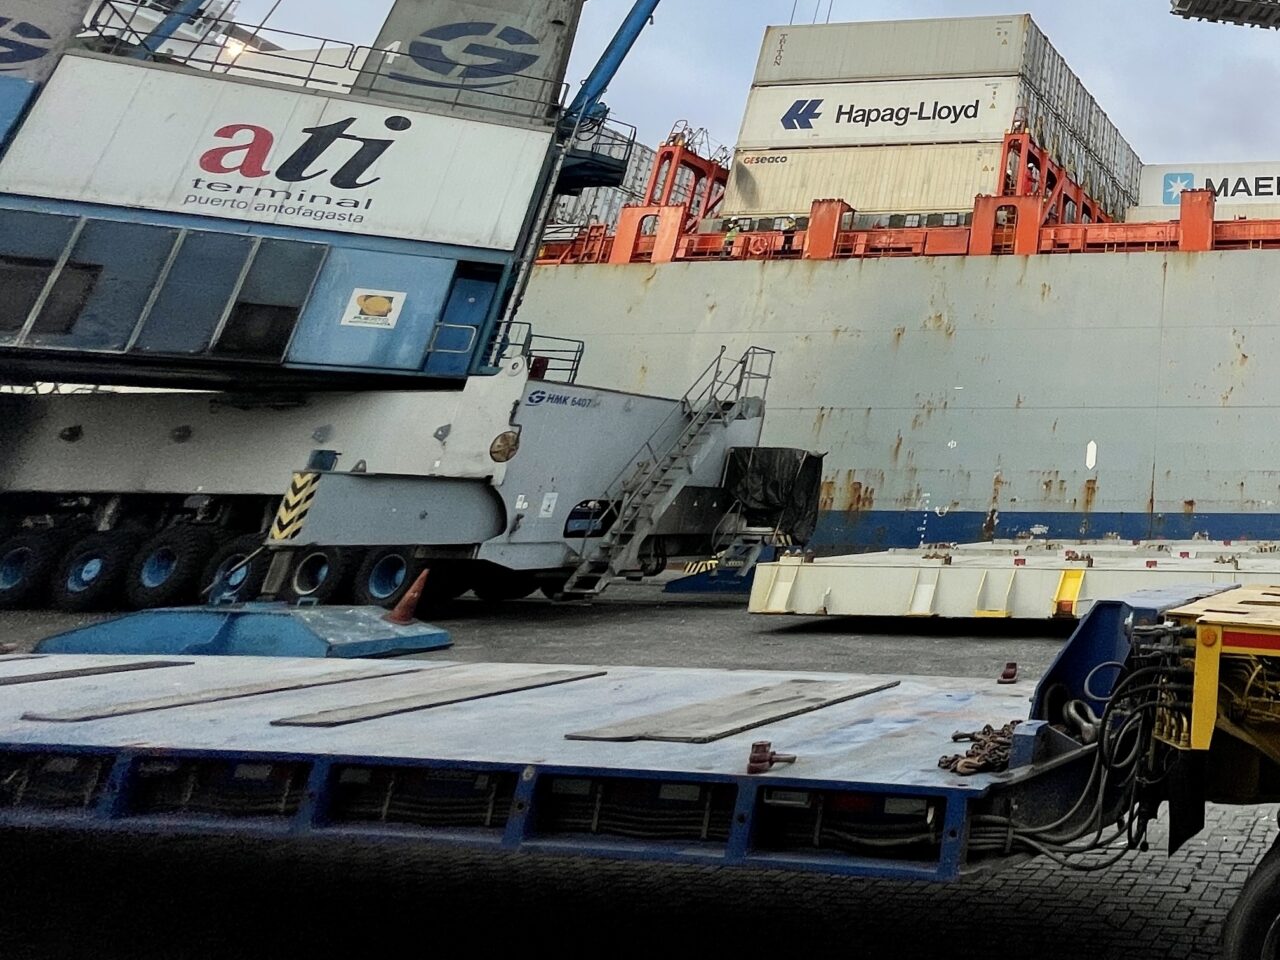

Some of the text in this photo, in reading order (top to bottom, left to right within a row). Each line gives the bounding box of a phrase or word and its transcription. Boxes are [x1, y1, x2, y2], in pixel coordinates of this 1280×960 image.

[835, 99, 980, 127] Hapag-Lloyd
[198, 114, 413, 190] ati
[183, 193, 365, 224] puerto antofagasta
[191, 177, 373, 210] terminal
[546, 393, 570, 406] HMK
[571, 397, 593, 409] 6407
